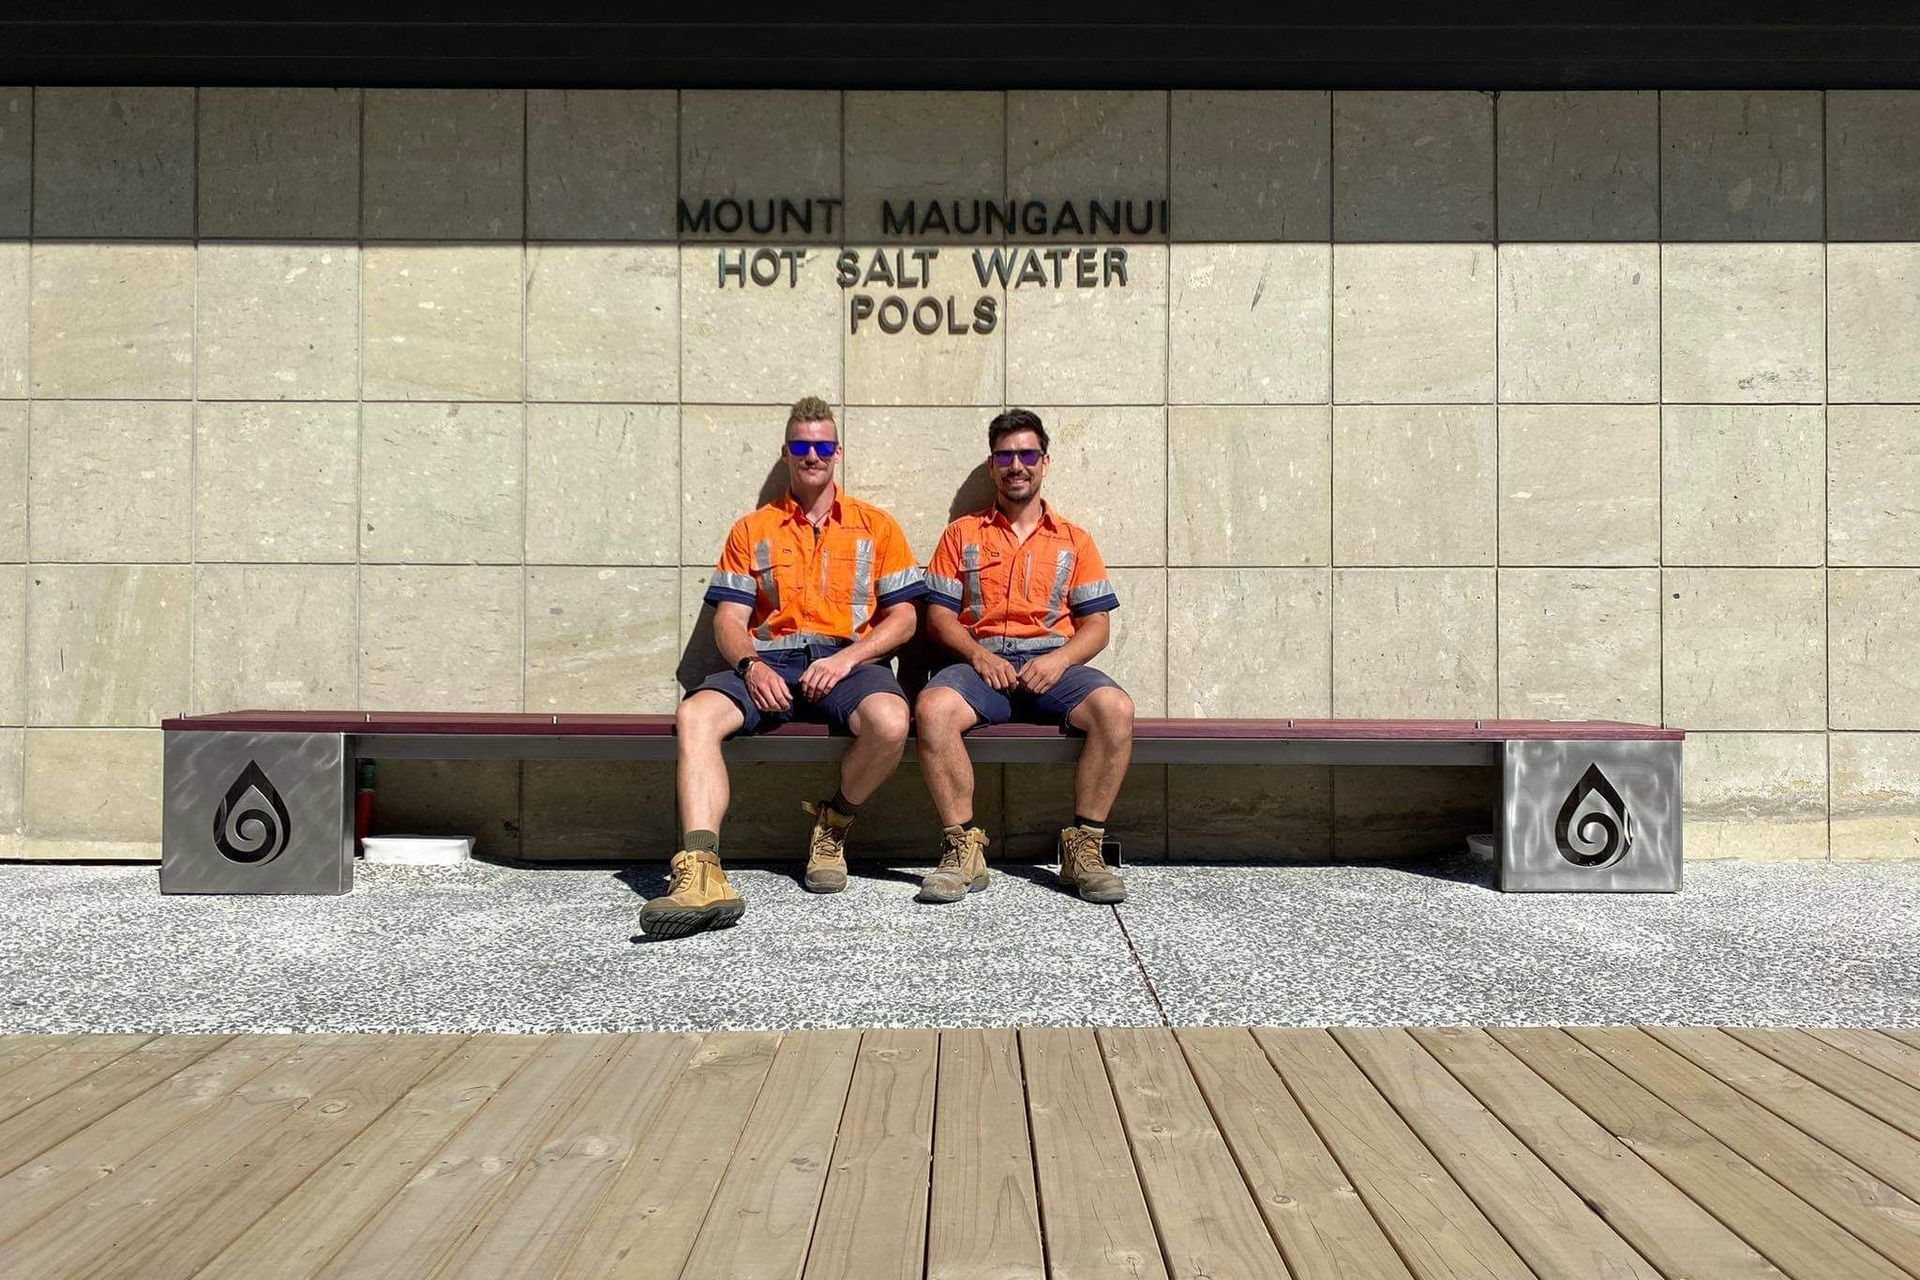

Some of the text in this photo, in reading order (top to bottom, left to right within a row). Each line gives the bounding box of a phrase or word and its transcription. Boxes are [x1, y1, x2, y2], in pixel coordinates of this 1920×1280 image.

[678, 199, 1169, 236] MOUNT MAUNGANUI
[718, 248, 1129, 289] HOT SALT WATER
[850, 295, 998, 335] POOLS
